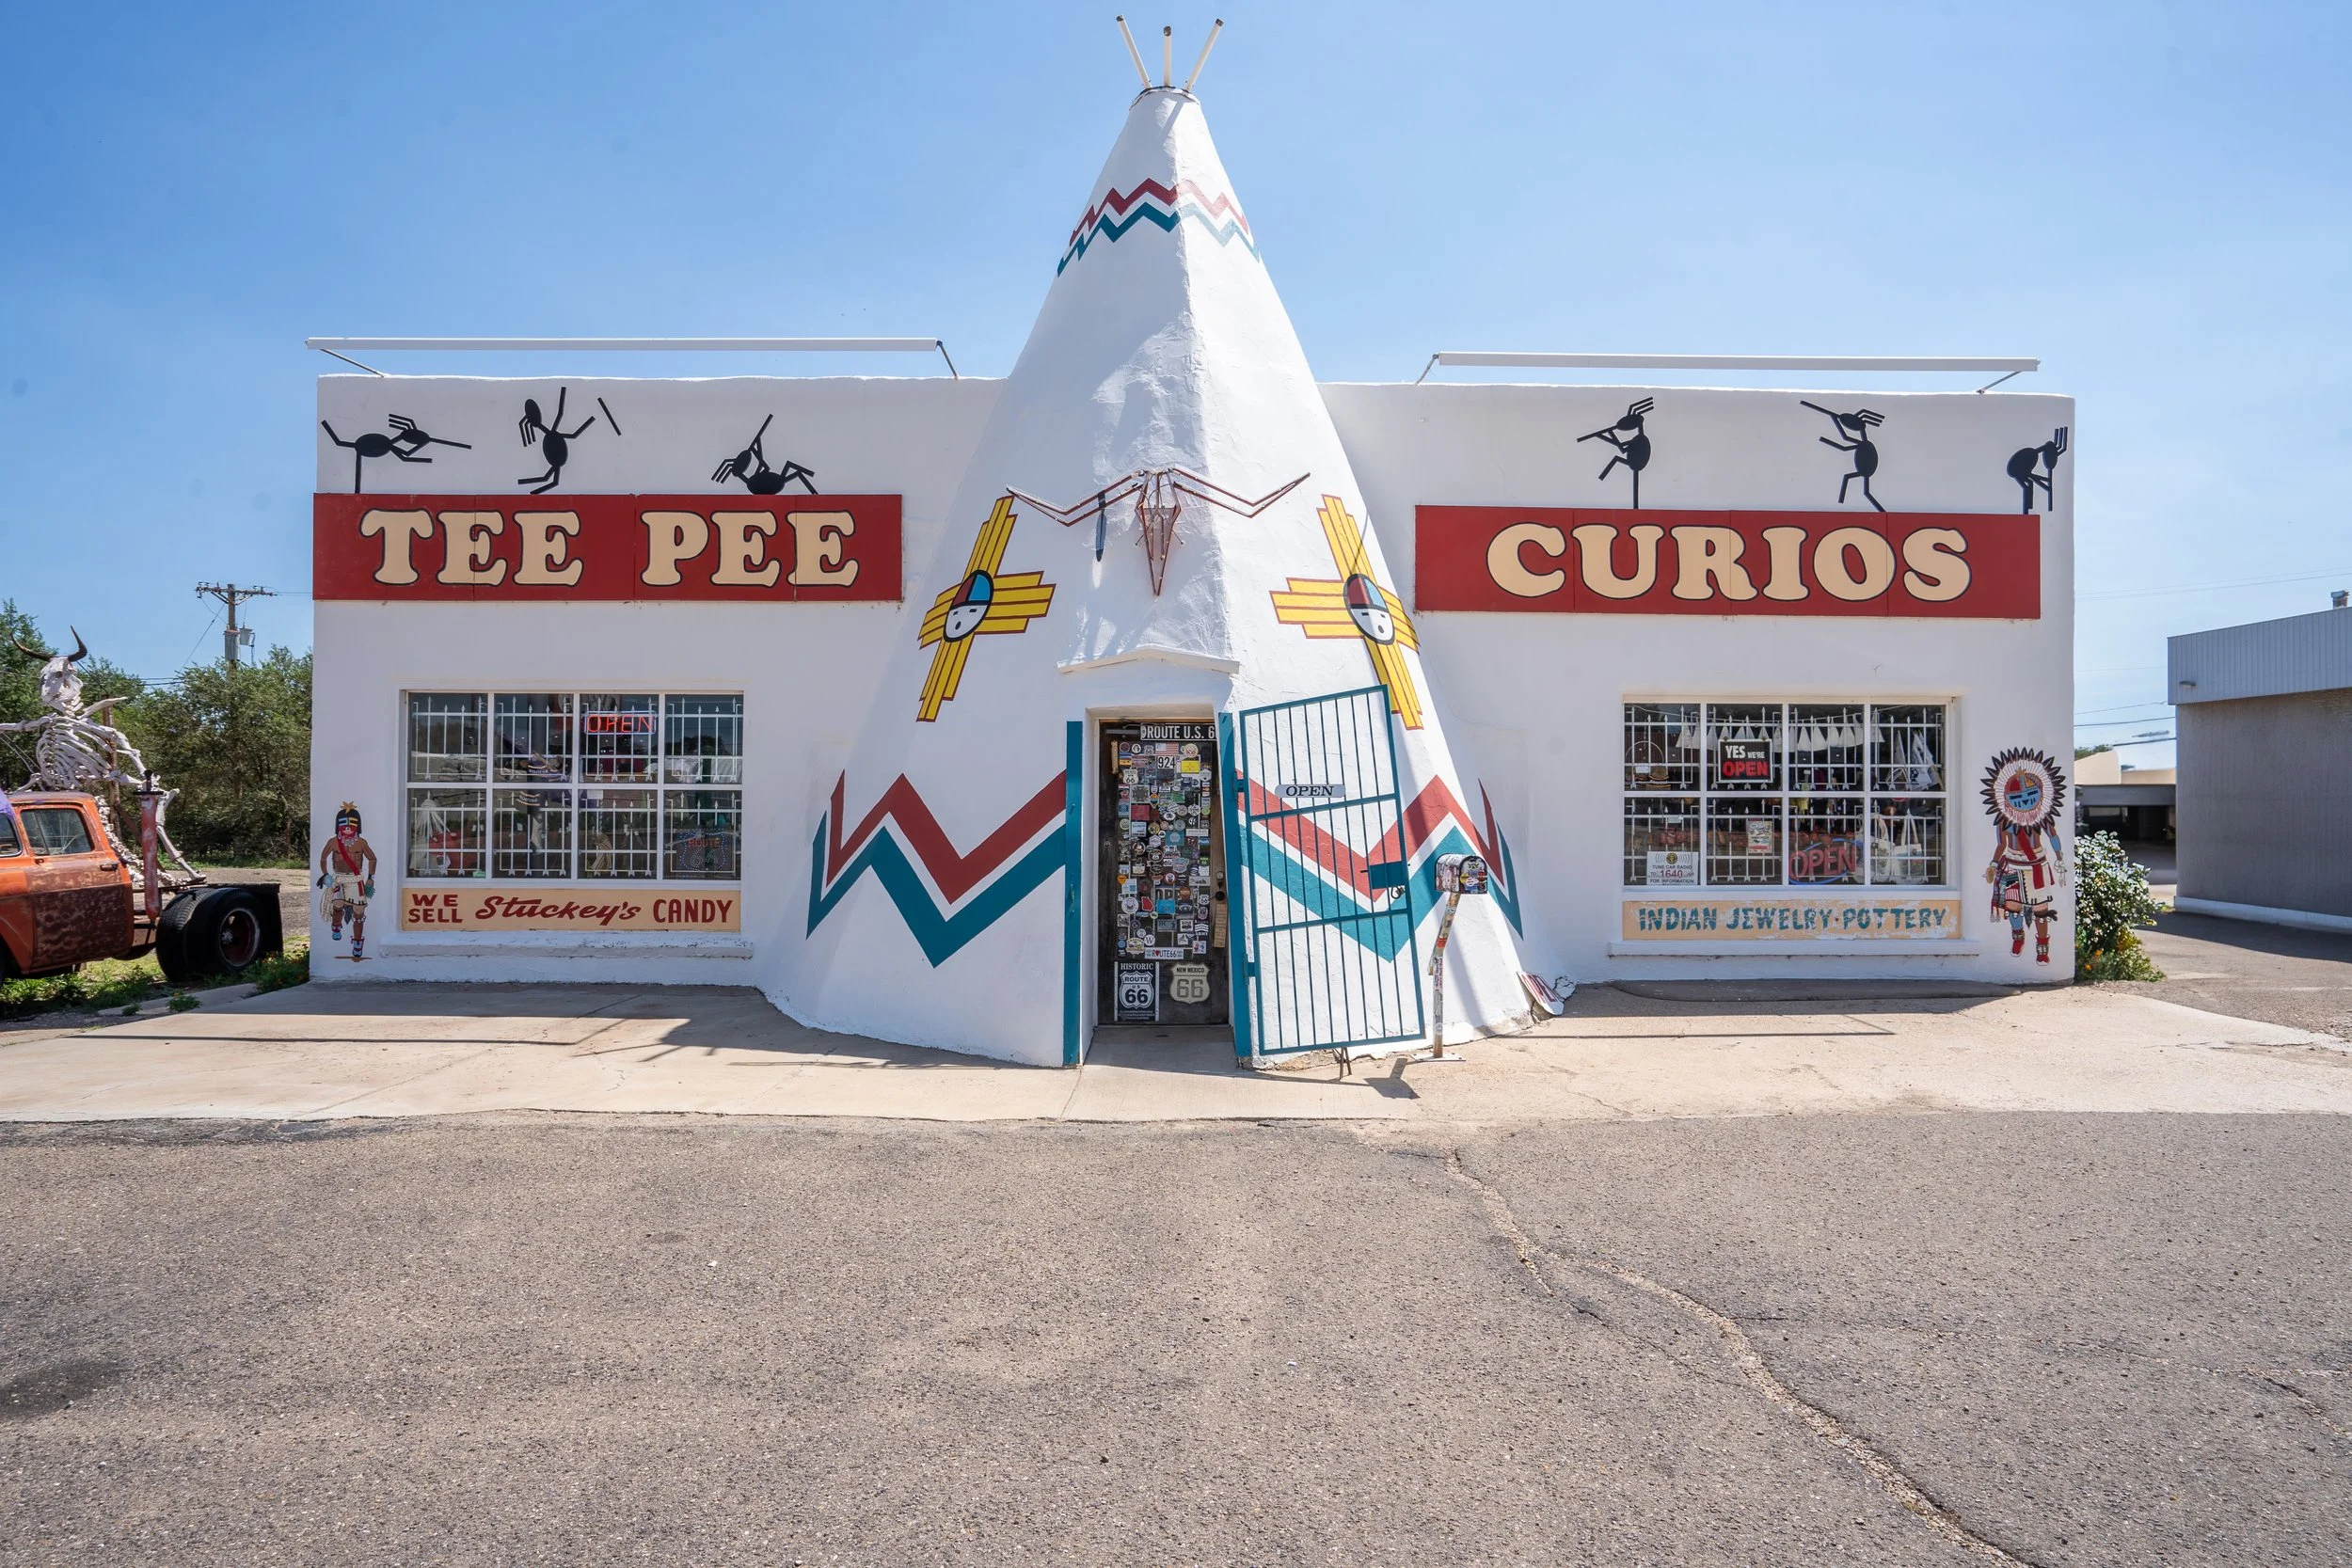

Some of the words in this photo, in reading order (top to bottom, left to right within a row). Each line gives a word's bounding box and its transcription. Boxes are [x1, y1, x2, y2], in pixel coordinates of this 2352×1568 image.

[359, 509, 583, 587] TEE
[640, 509, 859, 587] PEE
[1486, 522, 1972, 602] CURIOS
[587, 714, 653, 733] OPEN
[1148, 725, 1180, 739] ROUTE
[1184, 725, 1204, 739] U.S.
[1208, 725, 1216, 739] 6
[1724, 745, 1746, 758] YES
[1158, 756, 1175, 768] 924
[1723, 761, 1769, 777] OPEN
[1285, 785, 1334, 797] OPEN
[1788, 846, 1855, 879] OPEN
[412, 894, 458, 907] WE
[408, 909, 463, 923] SELL
[475, 895, 642, 926] Stuckey's
[653, 899, 733, 924] CANDY
[1639, 907, 1717, 930] INDIAN
[1726, 907, 1832, 930] JEWELRY
[1843, 908, 1947, 929] POTTERY
[1177, 978, 1203, 998] 66
[1125, 989, 1148, 1004] 66
